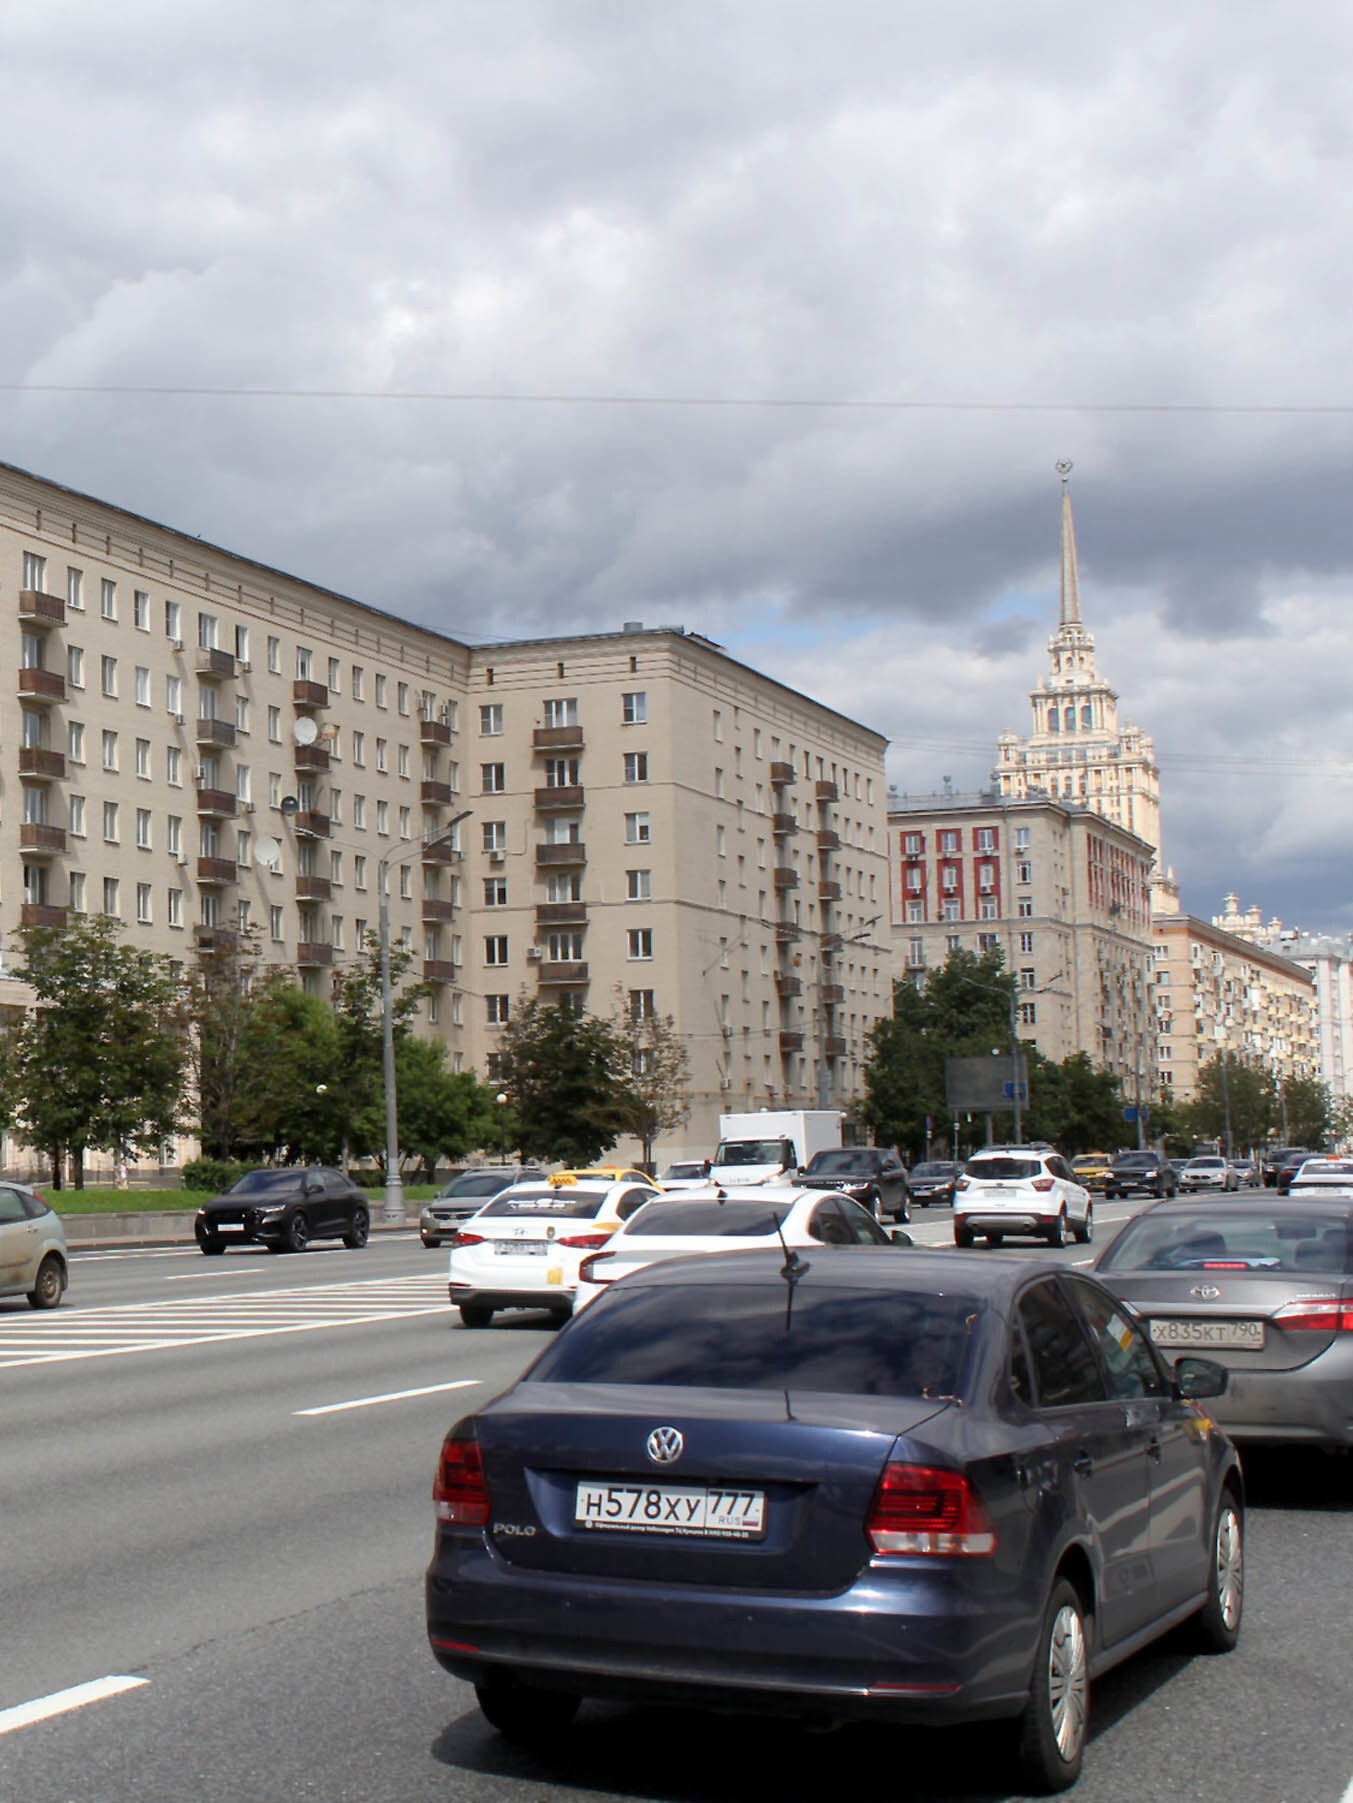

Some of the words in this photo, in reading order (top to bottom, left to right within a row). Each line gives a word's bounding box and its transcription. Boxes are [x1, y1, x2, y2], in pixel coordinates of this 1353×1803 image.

[1231, 1323, 1258, 1337] 790
[709, 1490, 756, 1517] 777
[718, 1515, 741, 1527] RUS
[493, 1522, 536, 1536] POLO
